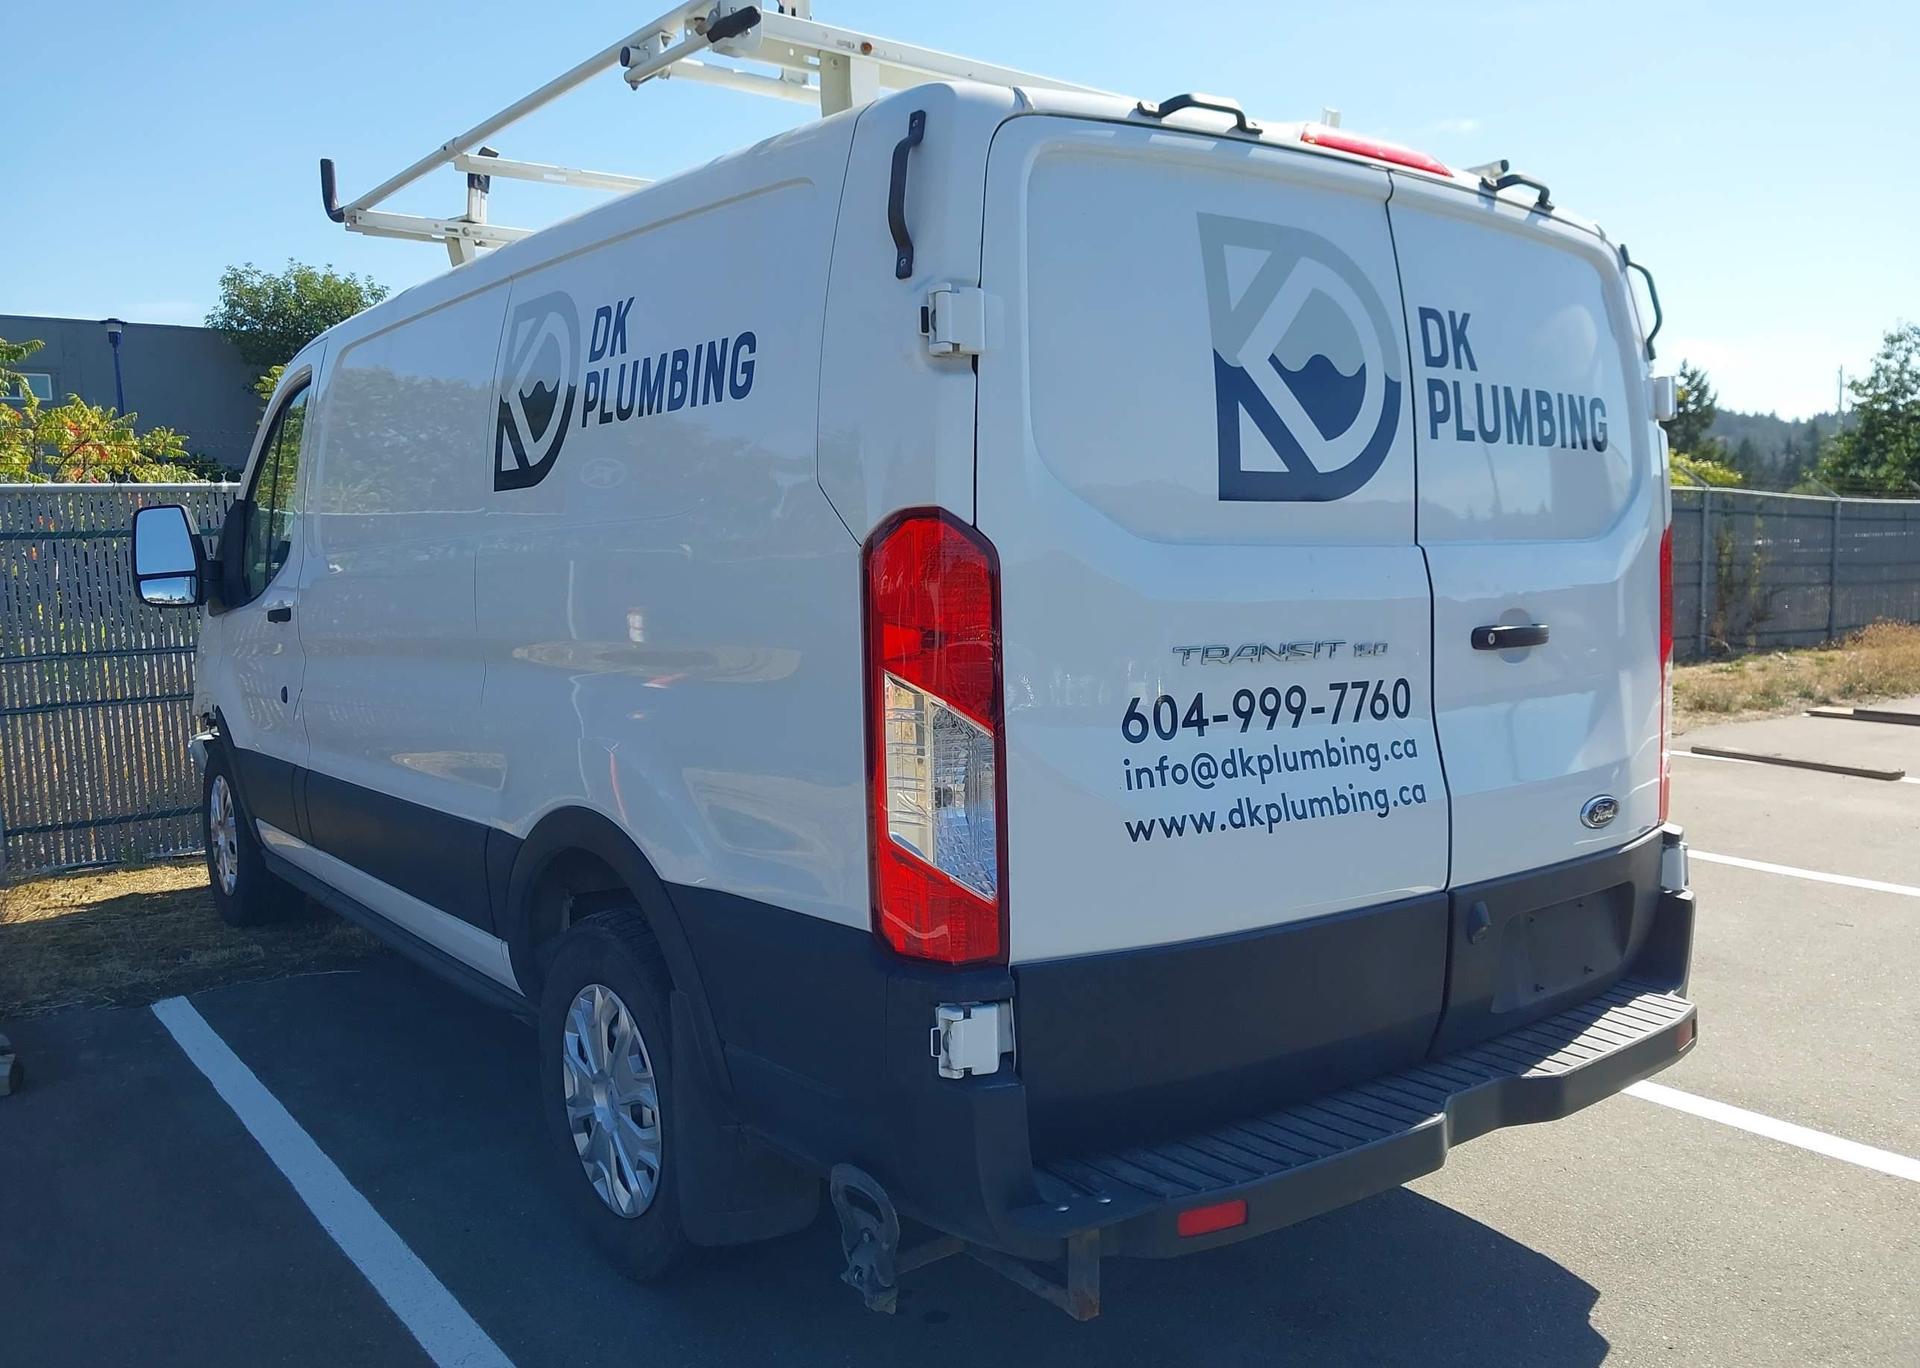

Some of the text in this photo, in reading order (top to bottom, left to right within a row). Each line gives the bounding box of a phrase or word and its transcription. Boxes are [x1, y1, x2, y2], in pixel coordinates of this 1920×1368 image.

[588, 297, 635, 363] DK
[1418, 306, 1478, 372] DK
[581, 331, 757, 428] PLUMBING
[1426, 378, 1609, 453] PLUMBING
[1172, 640, 1388, 666] TRANSIT 150
[1121, 677, 1411, 744] 604-999-7760
[1123, 736, 1418, 791] info@dkplumbing.ca
[1125, 783, 1427, 843] www.dkplumbing.ca
